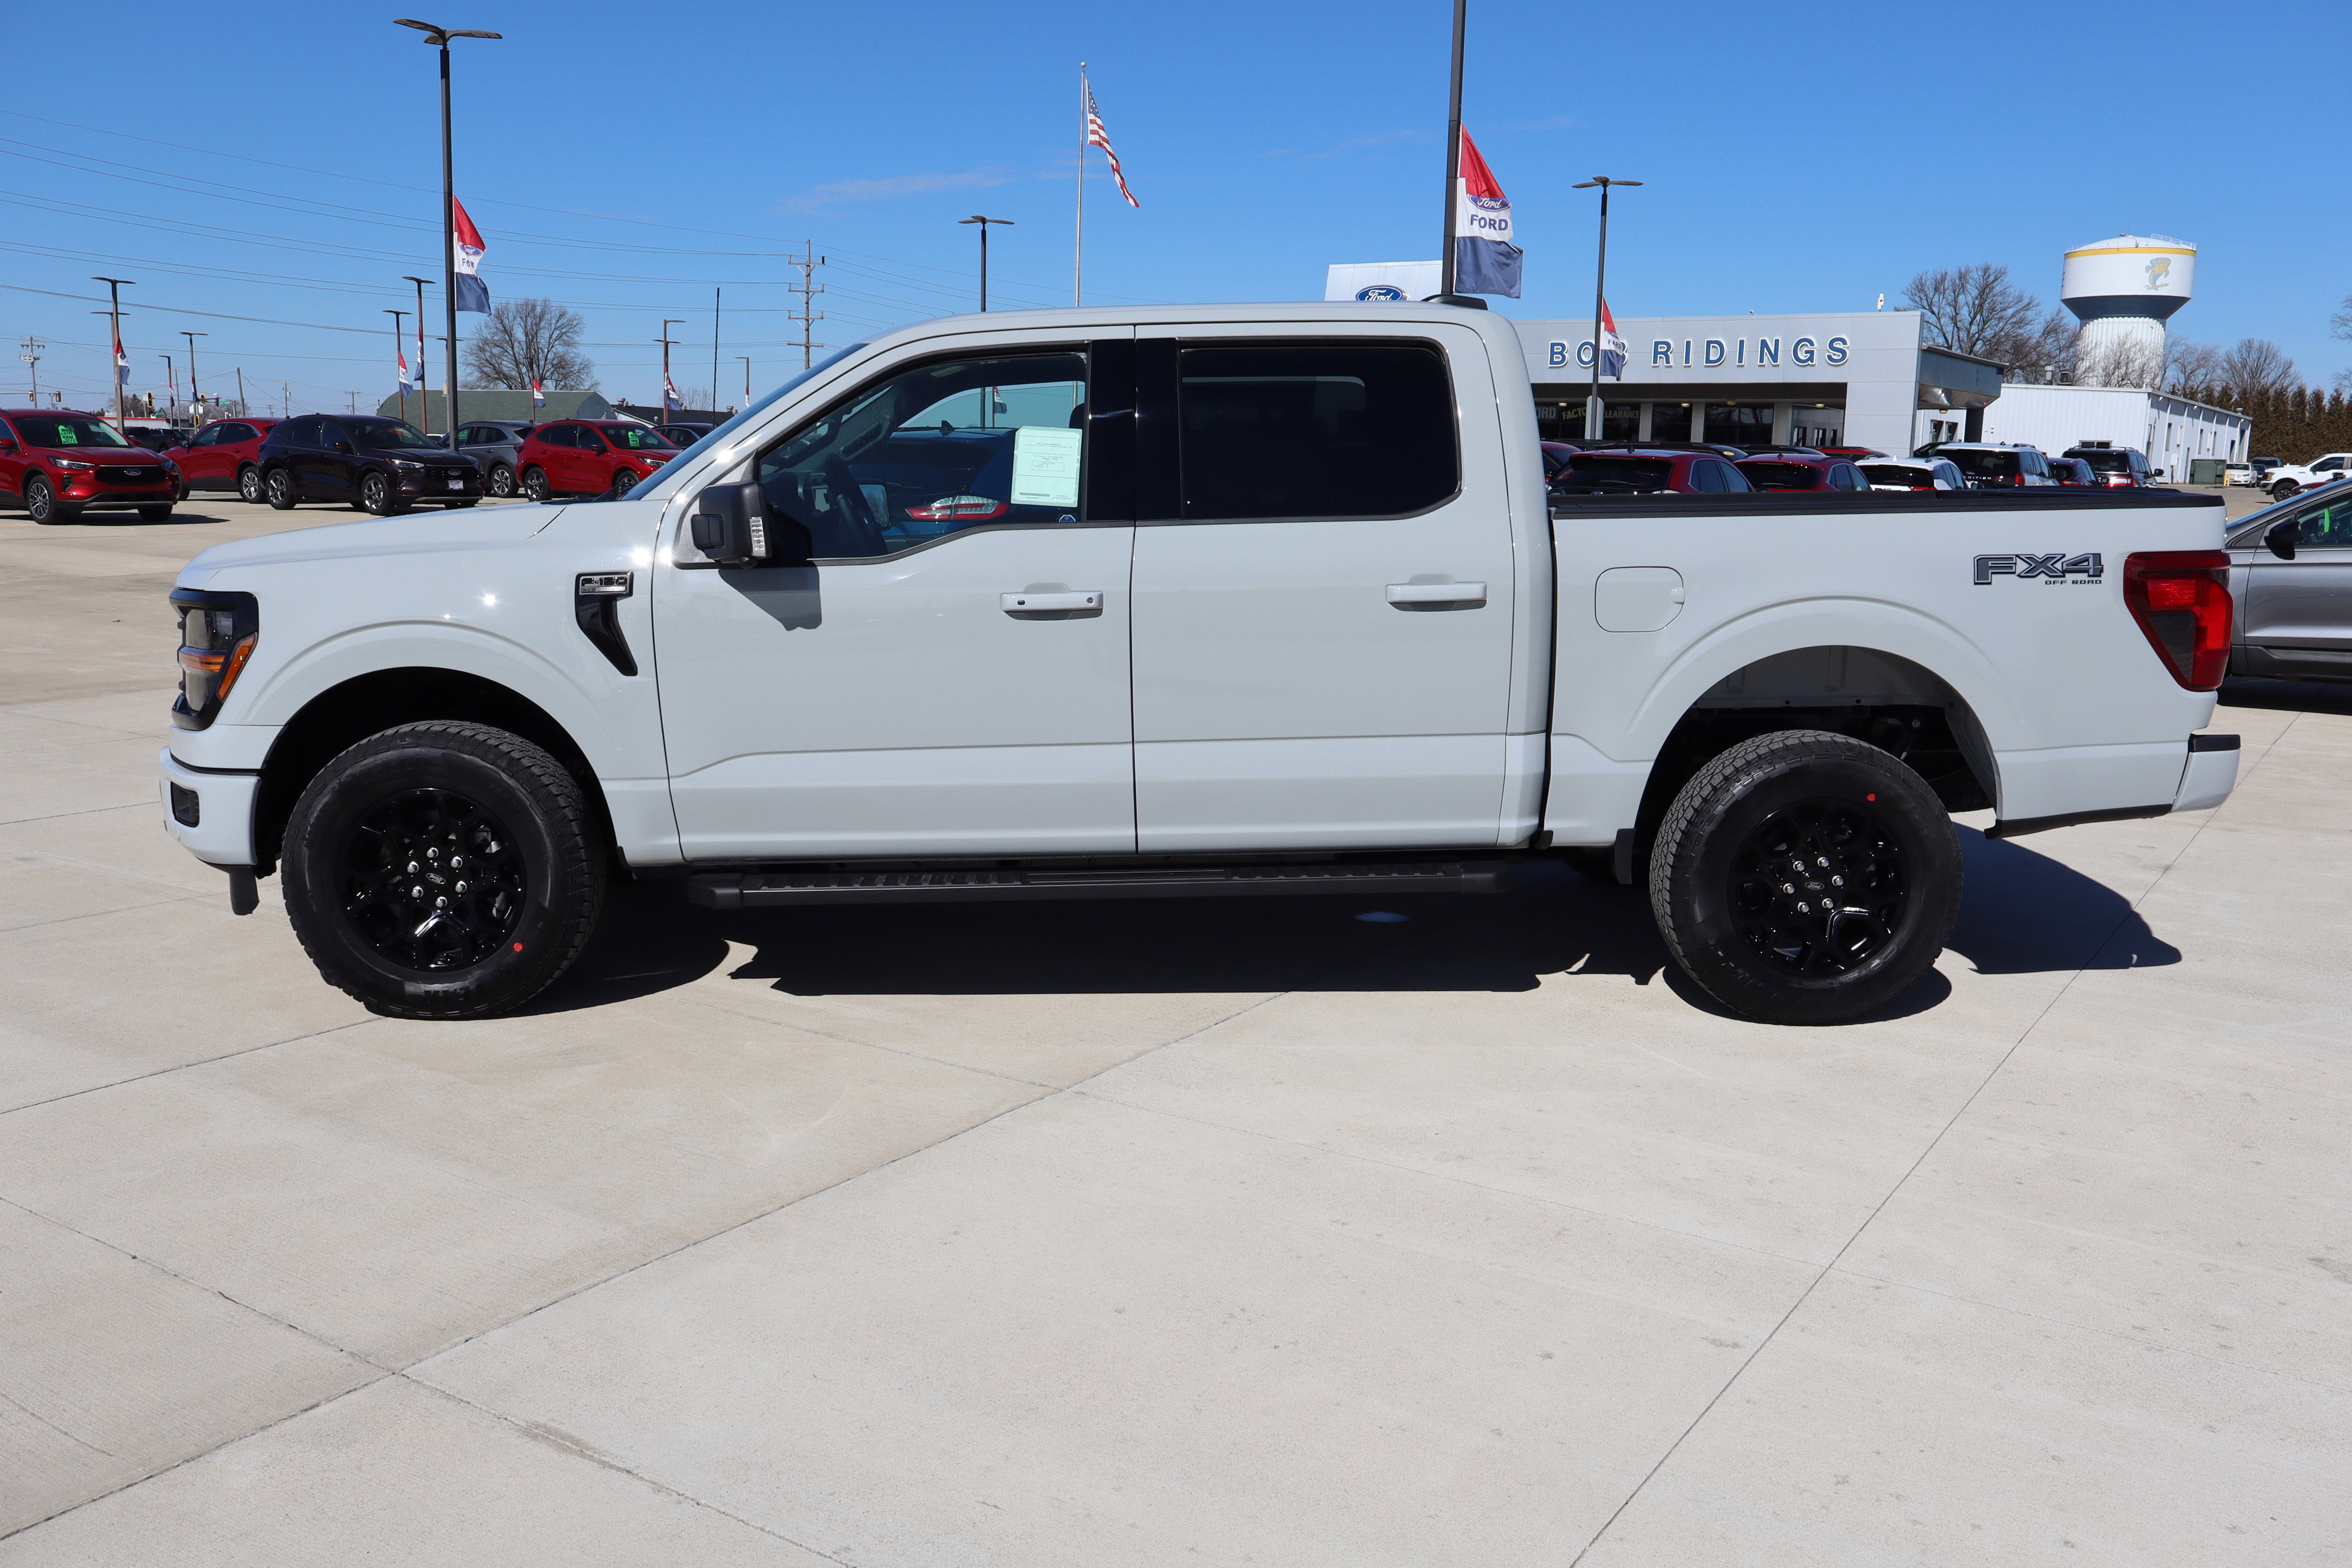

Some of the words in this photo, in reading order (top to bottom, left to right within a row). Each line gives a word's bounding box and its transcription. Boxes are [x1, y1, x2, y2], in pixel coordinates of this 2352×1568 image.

[1477, 198, 1502, 208] Ford
[1470, 214, 1508, 231] FORD
[1365, 289, 1394, 301] Ford
[1608, 339, 1622, 349] FORD
[1652, 336, 1850, 366] RIDINGS
[1562, 407, 1586, 420] FACTO
[1604, 410, 1639, 419] LEARANCE
[1973, 553, 2103, 585] FX4
[581, 576, 628, 586] F-150
[429, 875, 443, 883] Ford
